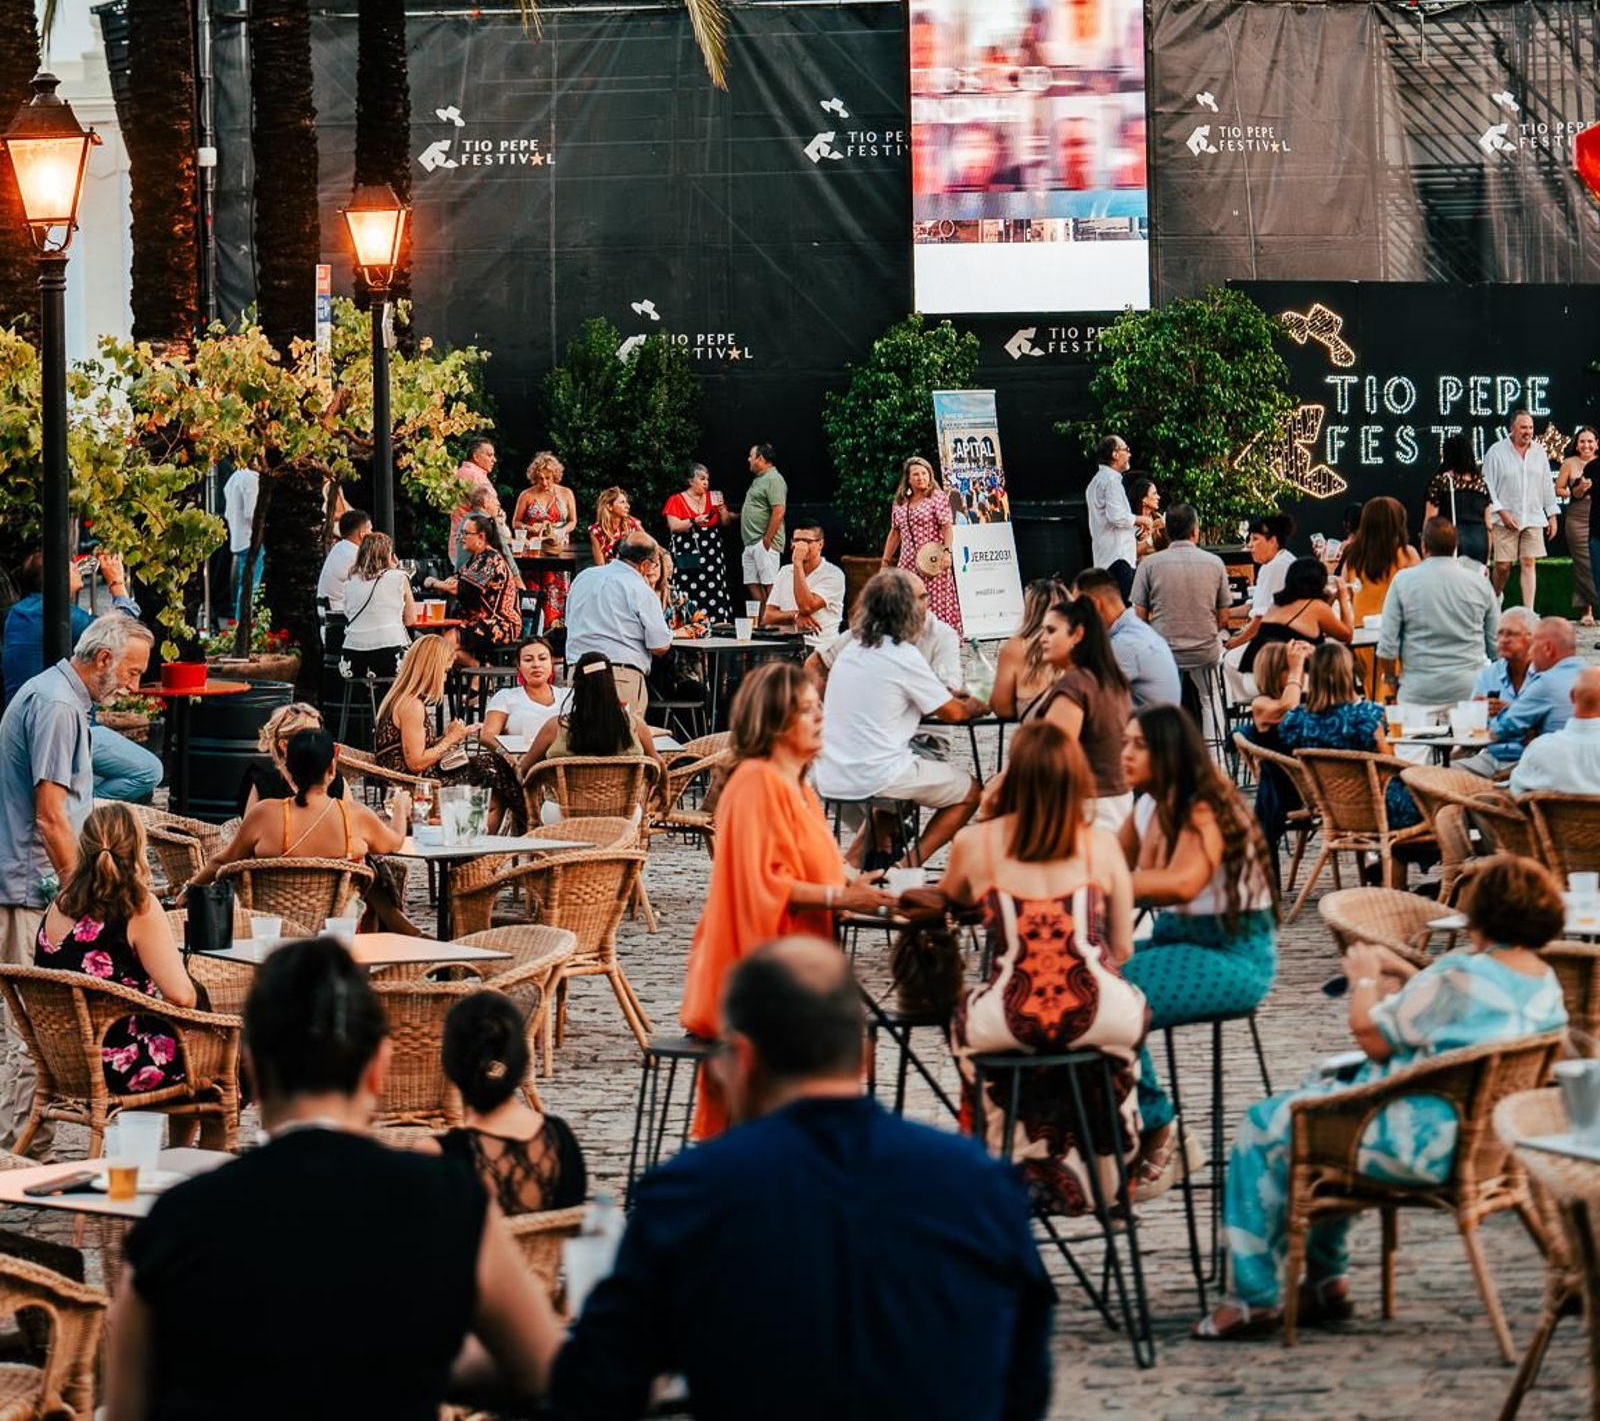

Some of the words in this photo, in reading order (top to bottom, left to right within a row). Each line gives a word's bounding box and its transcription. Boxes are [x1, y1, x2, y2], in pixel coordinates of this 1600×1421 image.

[1219, 126, 1242, 138] TIO
[1247, 126, 1274, 139] PEPE
[1519, 123, 1548, 135] TIO
[847, 131, 877, 143] TIO
[886, 131, 904, 142] PE
[1520, 135, 1572, 149] FESTI
[461, 140, 493, 152] TIO
[500, 139, 539, 152] PEPE
[847, 145, 903, 157] FESTI
[671, 334, 688, 346] IO
[697, 333, 736, 346] PEPE
[1050, 327, 1079, 339] TIO
[1049, 340, 1102, 353] FESTI
[1325, 375, 1417, 415] TIO
[1438, 375, 1551, 416] PEPE
[949, 440, 995, 460] CAPITAL
[971, 550, 1011, 562] JEREZ2031
